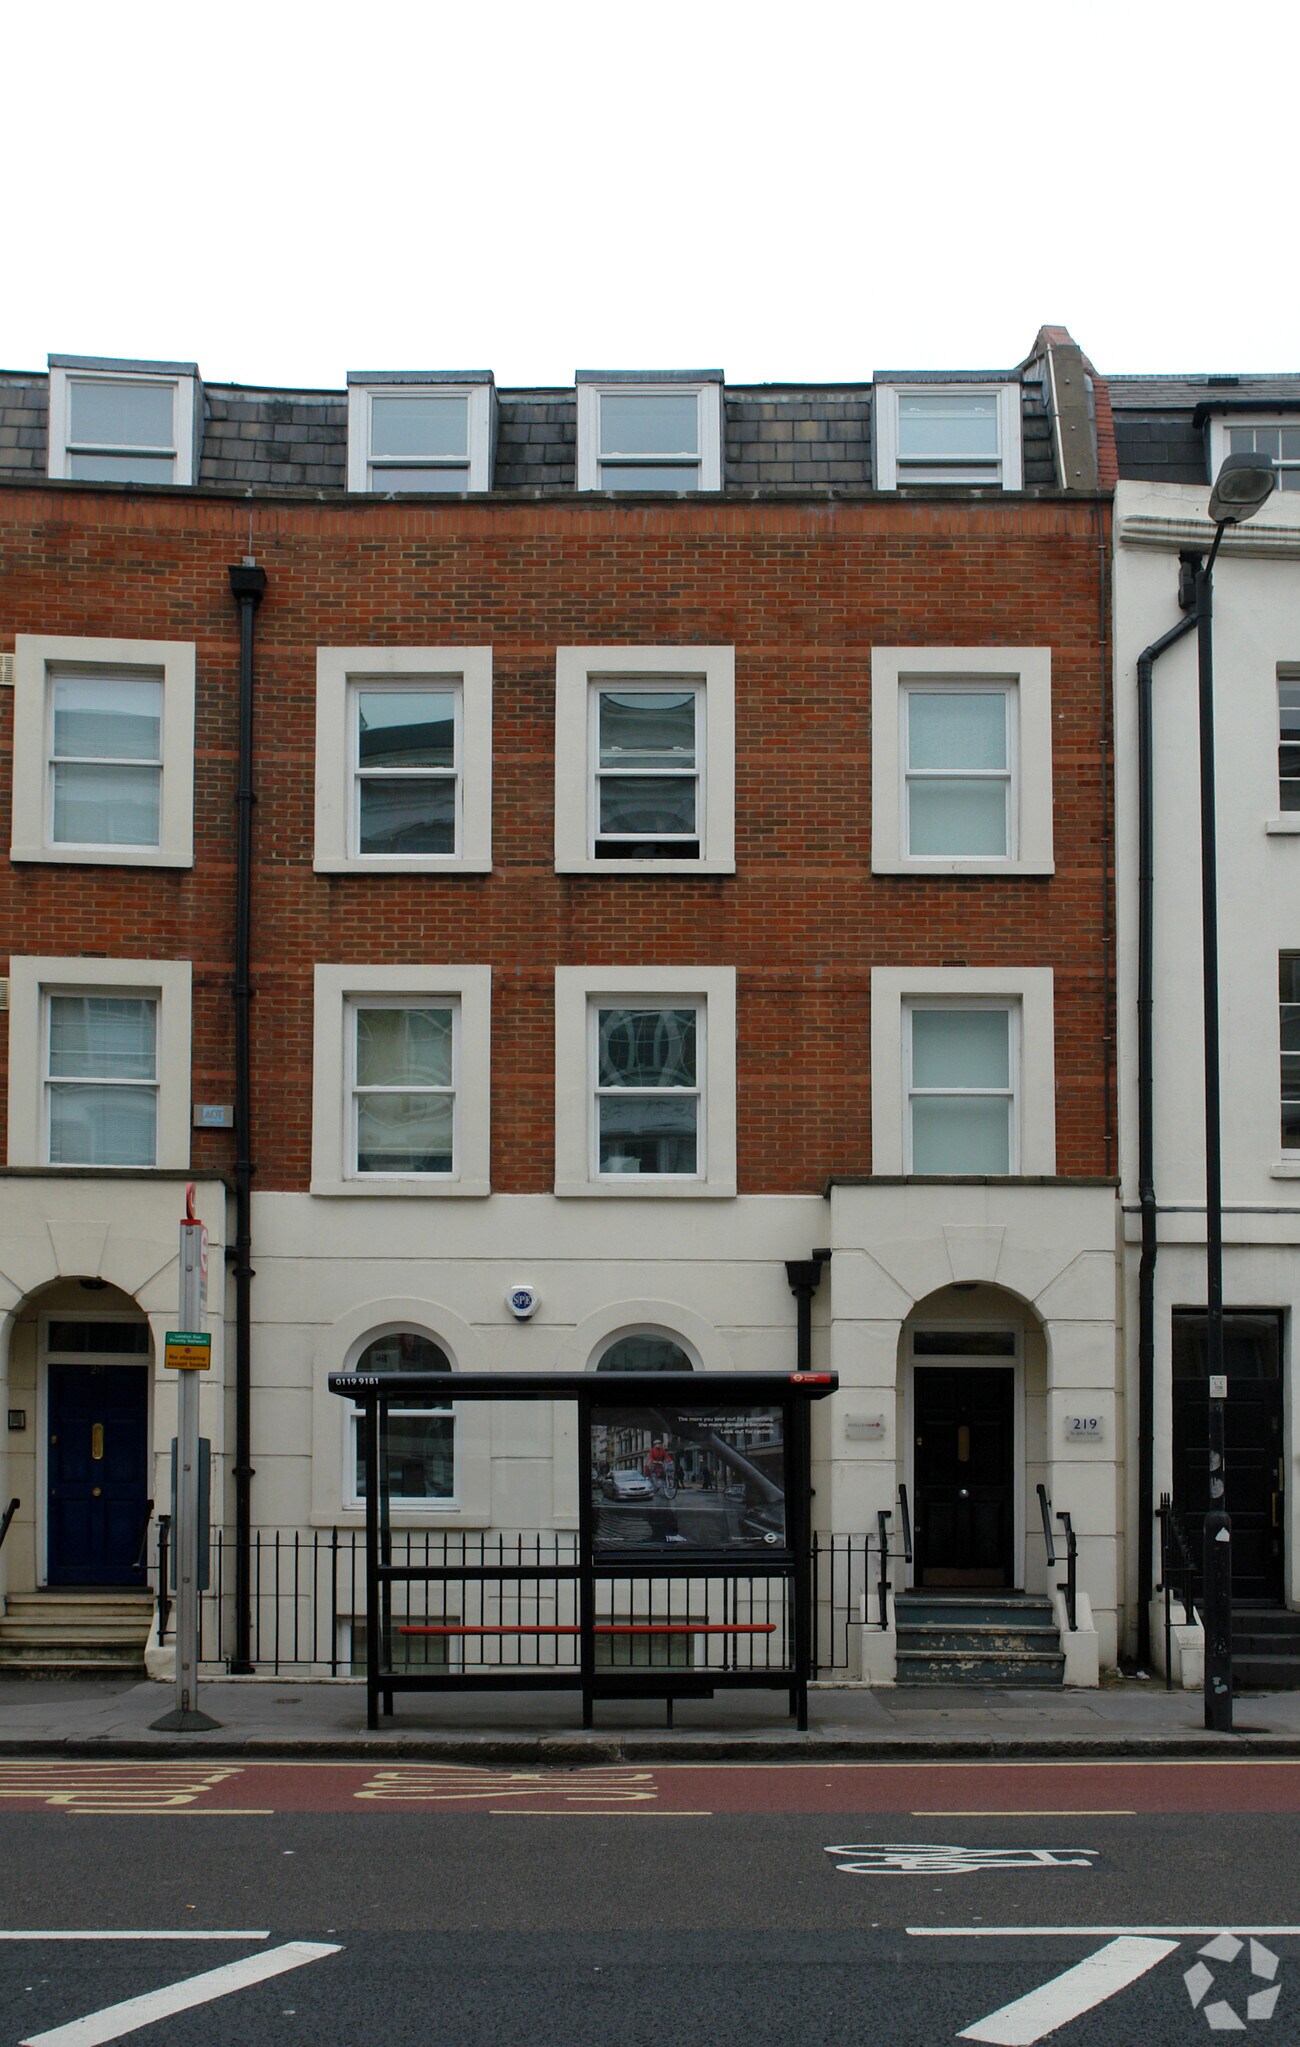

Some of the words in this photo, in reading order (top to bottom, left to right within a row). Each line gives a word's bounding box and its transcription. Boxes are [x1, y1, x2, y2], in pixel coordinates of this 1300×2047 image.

[203, 1109, 225, 1119] ADT
[512, 1295, 532, 1305] SPE
[1074, 1418, 1097, 1429] 219
